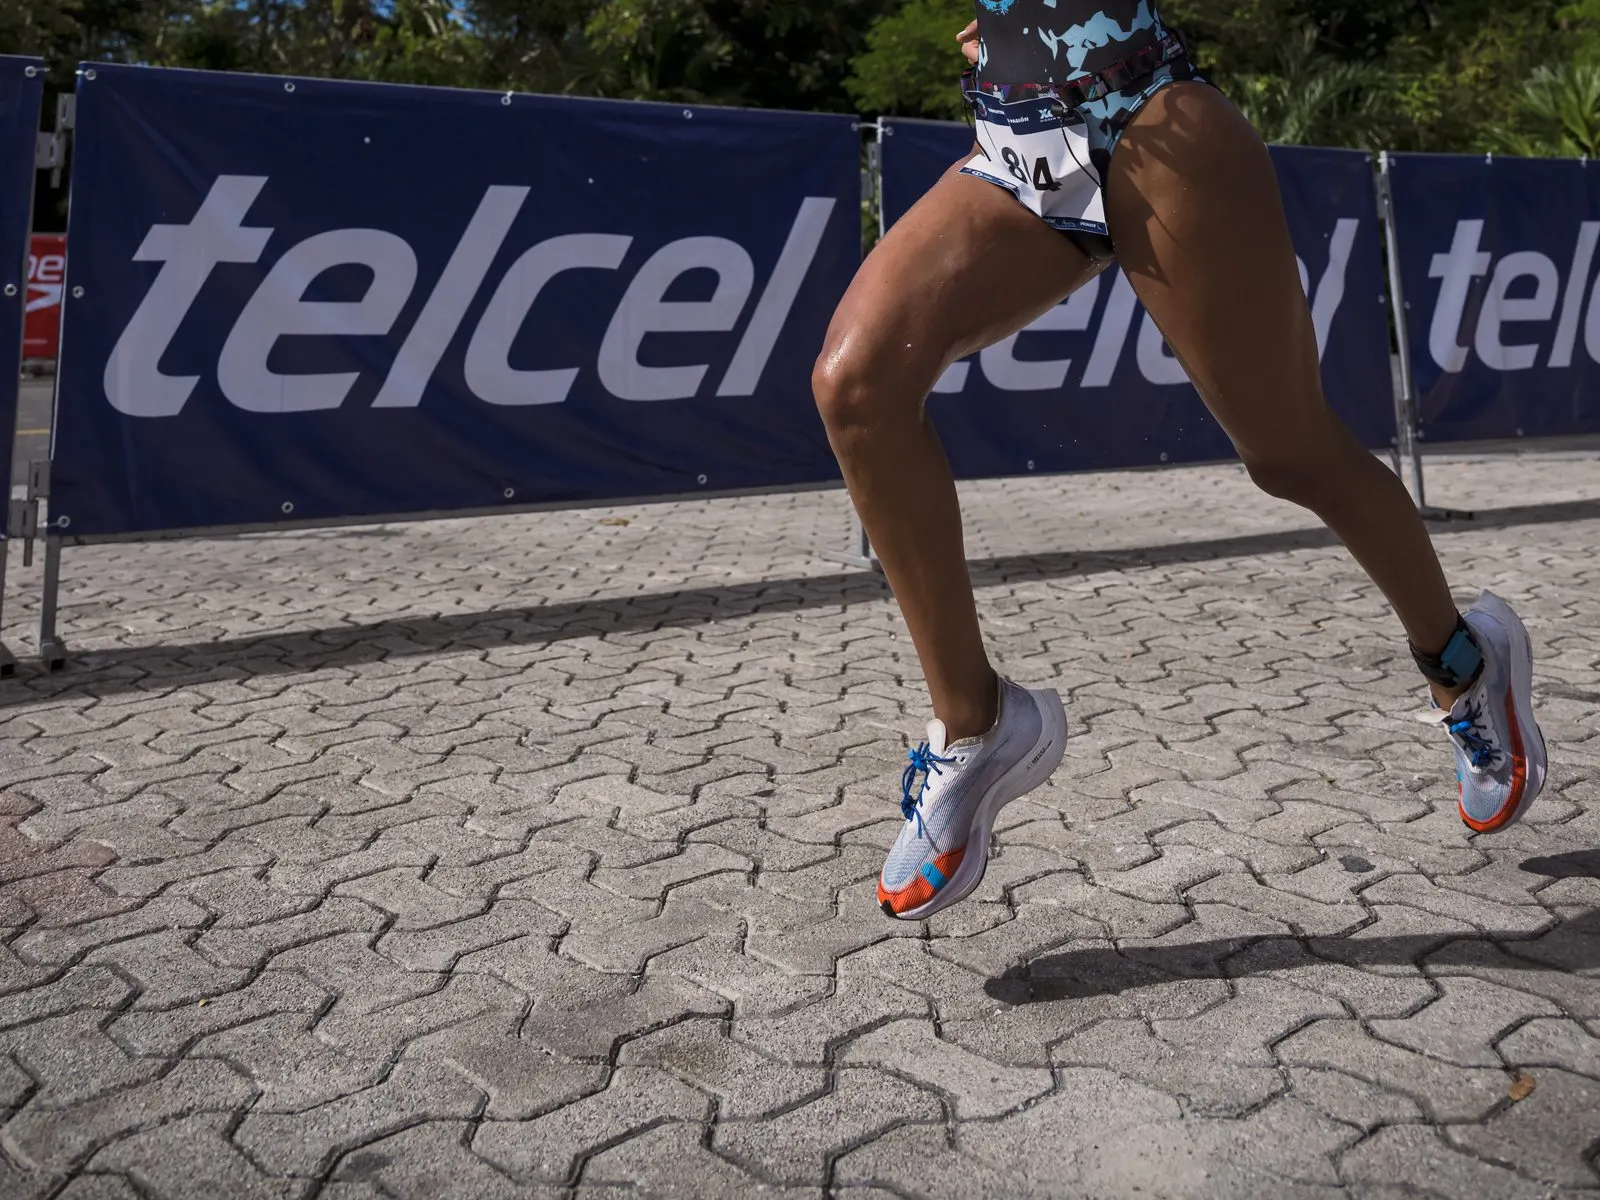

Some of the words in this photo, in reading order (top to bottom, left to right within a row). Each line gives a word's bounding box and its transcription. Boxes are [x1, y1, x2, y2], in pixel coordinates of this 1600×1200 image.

[1001, 146, 1062, 192] 84
[104, 175, 836, 417] telcel
[1428, 219, 1600, 373] tel
